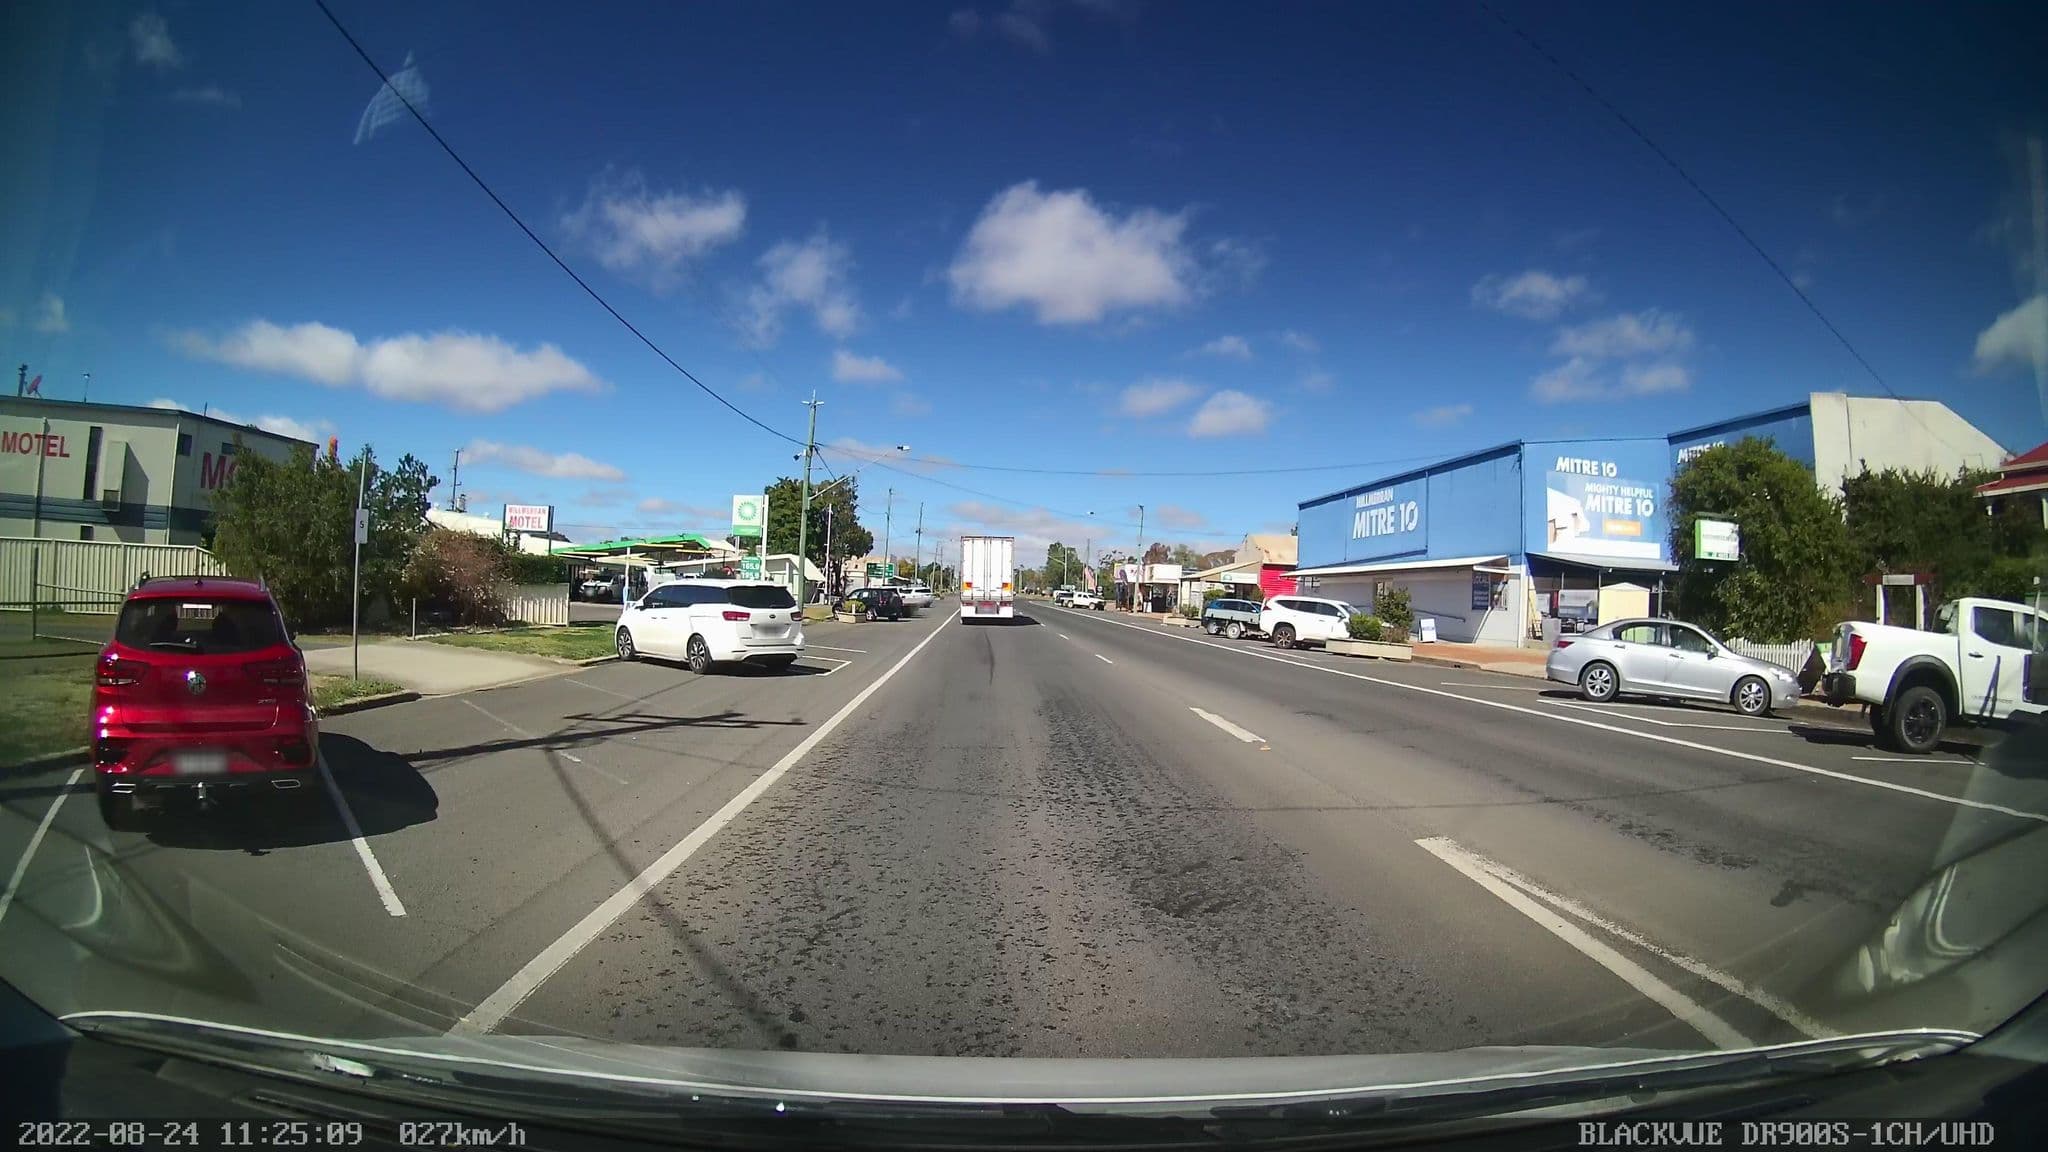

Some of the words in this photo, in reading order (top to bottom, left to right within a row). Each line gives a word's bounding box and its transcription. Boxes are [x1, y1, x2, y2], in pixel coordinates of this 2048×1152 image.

[2, 431, 70, 457] MOTEL
[1556, 456, 1599, 476] MITRE
[1602, 462, 1617, 478] 10
[1585, 482, 1619, 496] MIGHTY
[1621, 486, 1654, 499] HELPFUL
[1584, 494, 1633, 515] MITRE
[1636, 498, 1655, 517] 10
[510, 515, 544, 529] MOTEL
[1352, 505, 1395, 540] MITRE
[1400, 501, 1419, 532] 10
